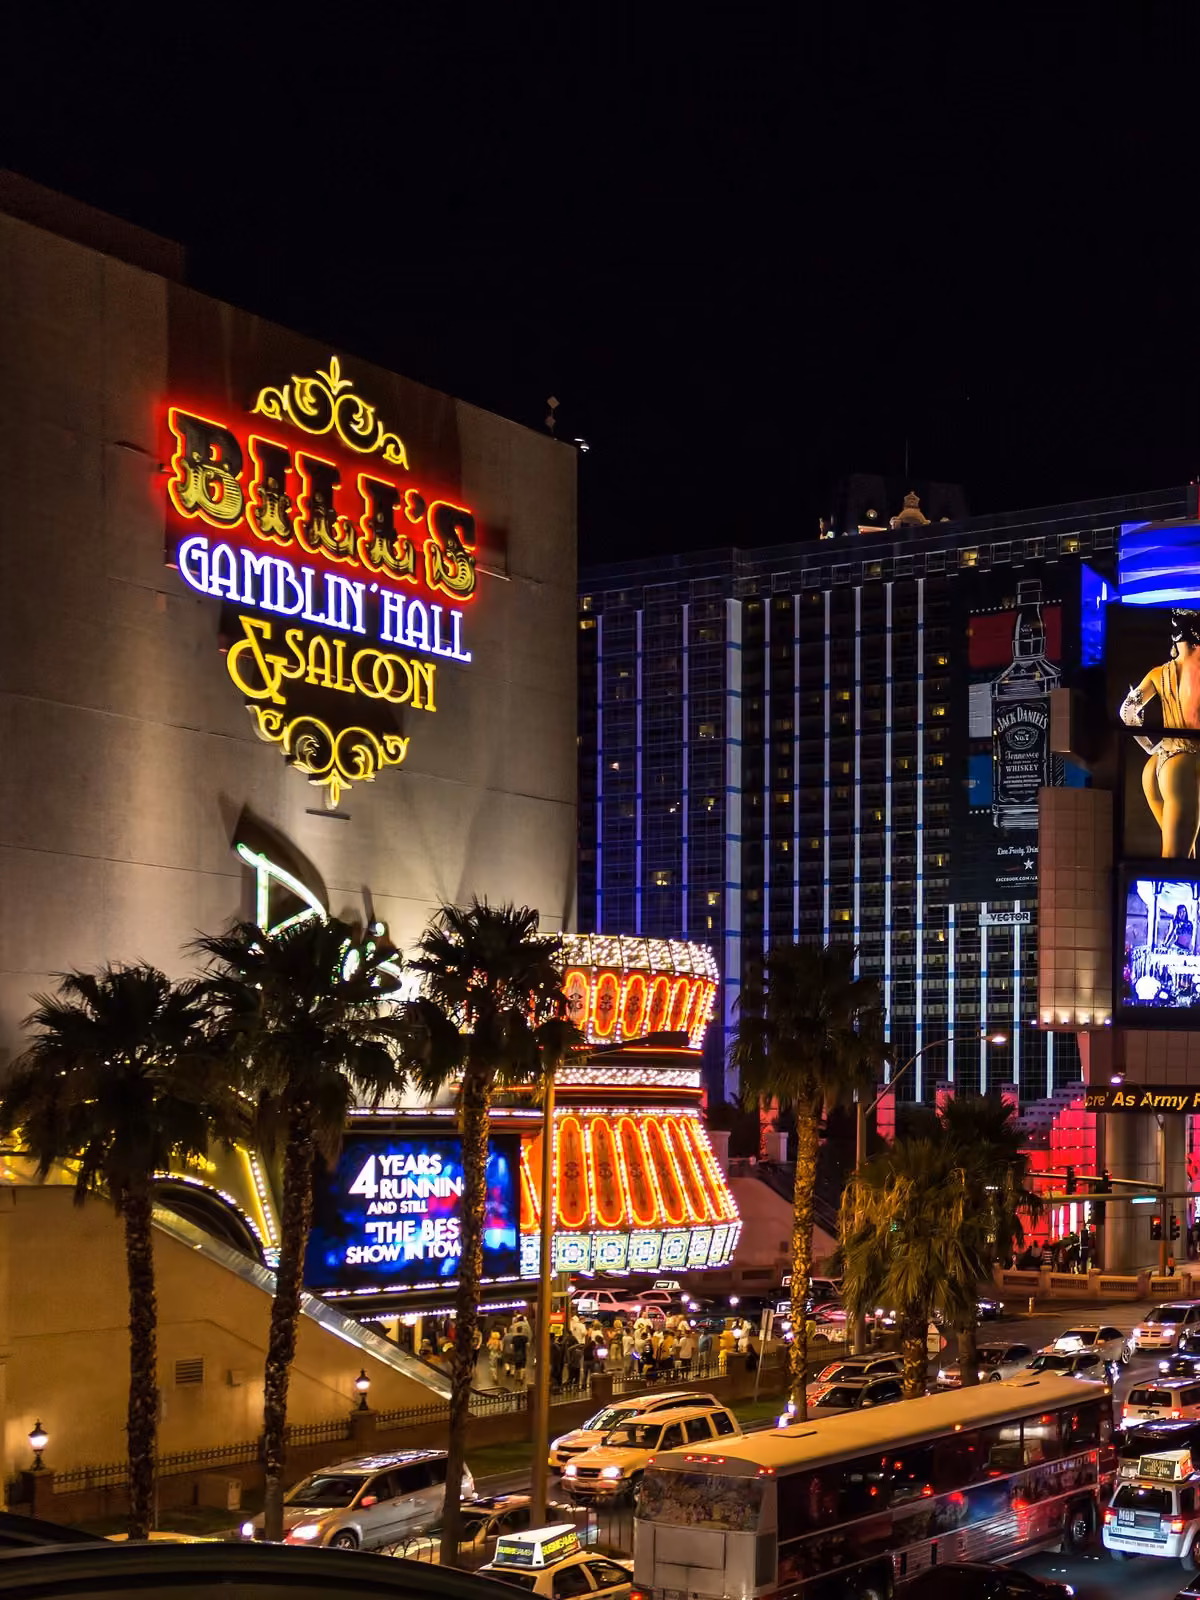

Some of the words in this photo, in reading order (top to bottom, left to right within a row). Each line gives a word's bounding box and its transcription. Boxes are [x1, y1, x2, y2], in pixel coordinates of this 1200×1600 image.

[168, 406, 477, 601] BILL'S
[380, 588, 472, 663] HALL
[226, 614, 288, 705] &
[283, 629, 437, 713] SALOON
[1005, 764, 1038, 772] WHISKEY
[991, 912, 1029, 922] VECTOR
[1112, 1091, 1135, 1107] As
[1140, 1091, 1188, 1111] Army
[348, 1154, 378, 1199] 4
[378, 1154, 442, 1176] YEARS
[380, 1176, 464, 1200] RUNNIN
[366, 1201, 397, 1215] AND
[399, 1199, 428, 1214] STILL
[421, 1217, 461, 1242] BES
[345, 1244, 401, 1264] SHOW
[404, 1241, 423, 1260] IN
[427, 1240, 462, 1259] TOW
